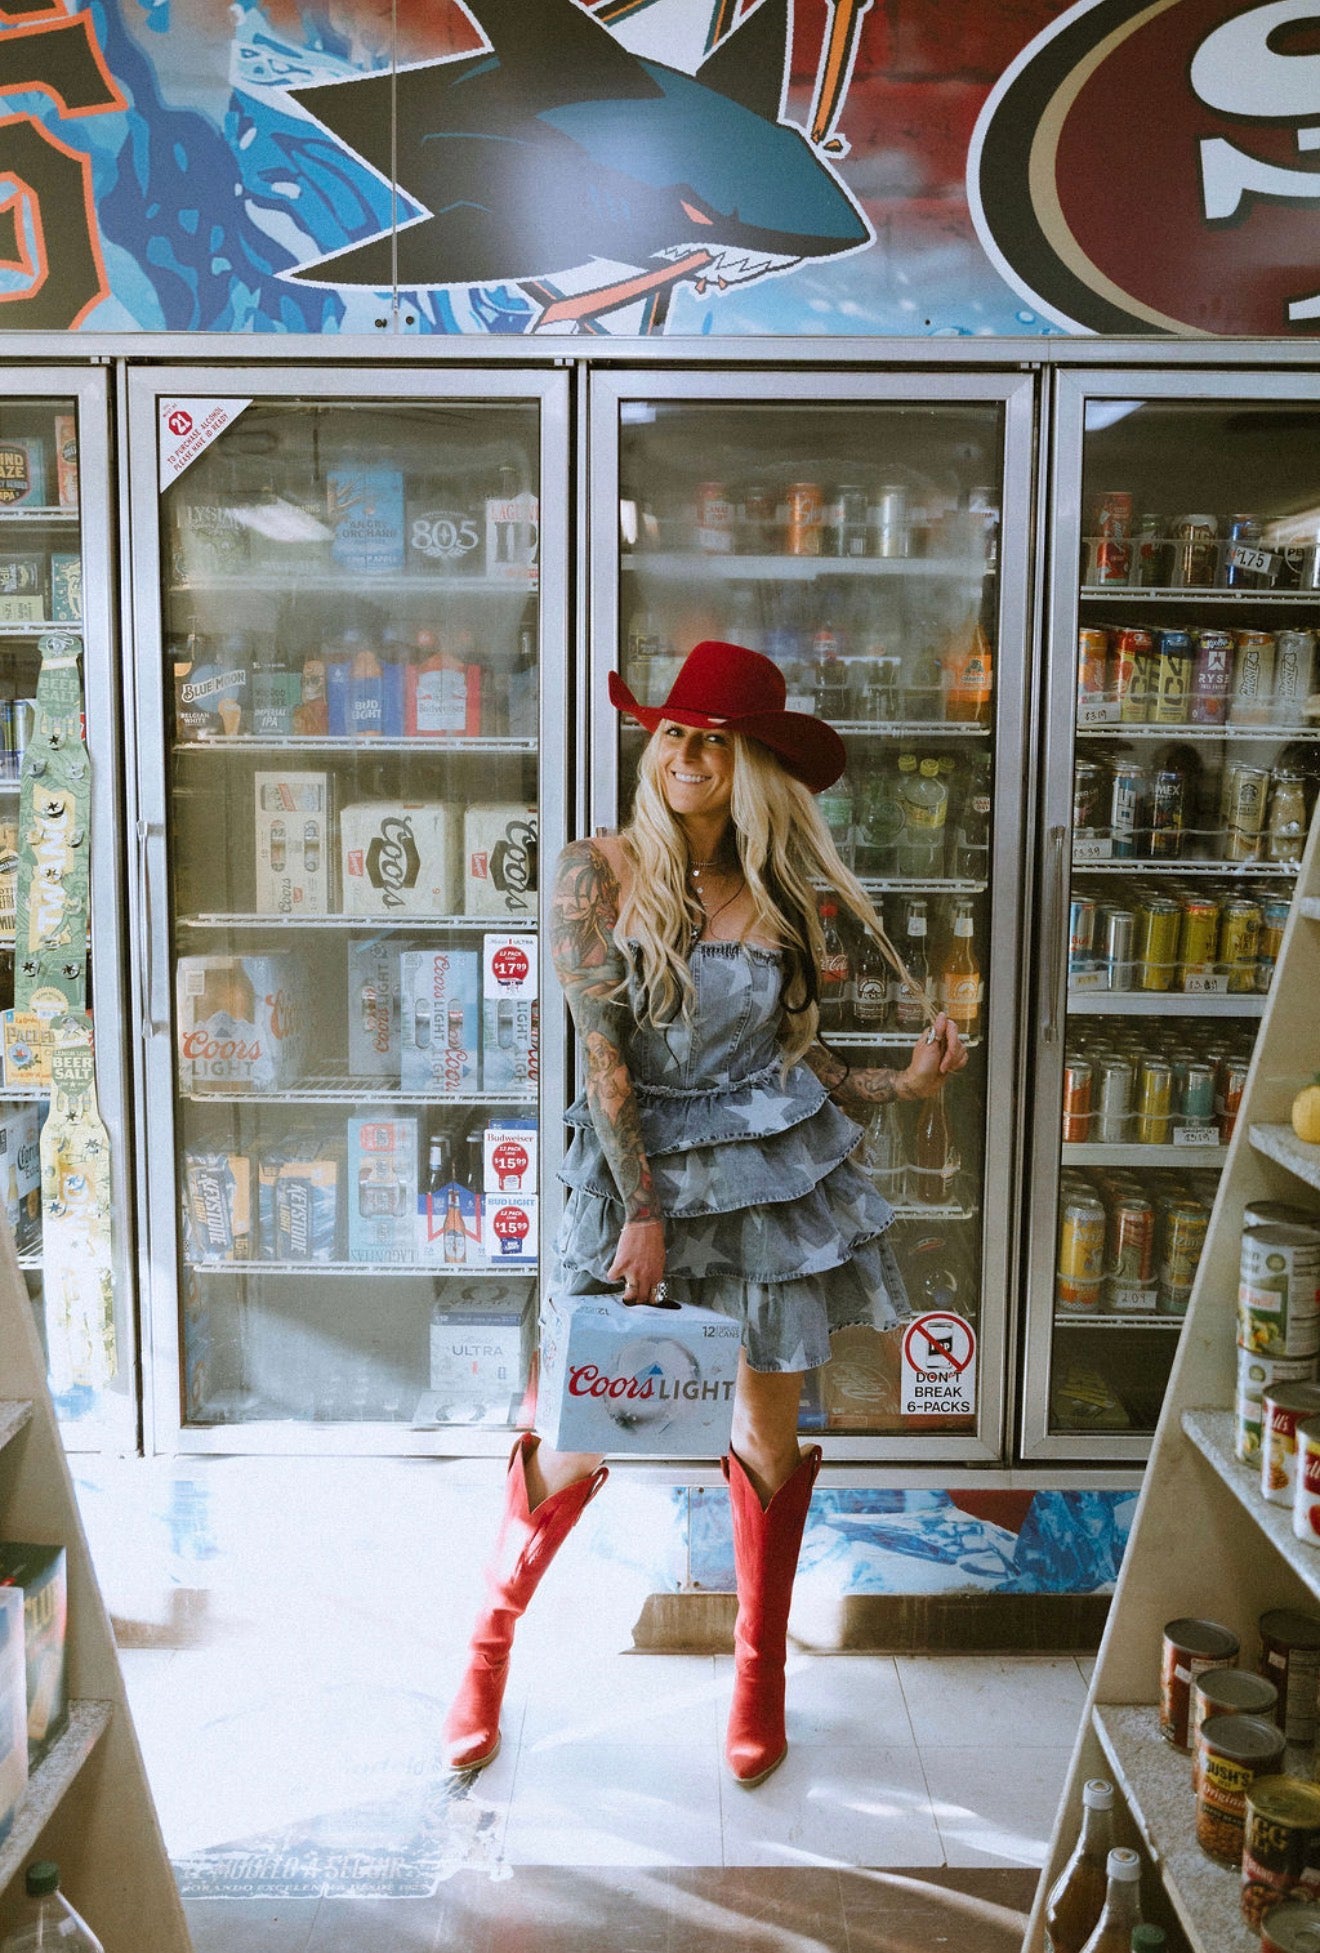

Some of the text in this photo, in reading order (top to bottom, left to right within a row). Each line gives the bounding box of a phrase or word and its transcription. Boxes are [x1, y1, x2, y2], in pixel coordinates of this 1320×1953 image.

[167, 406, 224, 464] TO PURCHASE ALCOHOL
[170, 412, 192, 434] 21
[173, 451, 194, 472] PLEASE
[191, 437, 206, 452] HAVE
[210, 413, 229, 431] READY
[411, 520, 479, 550] 805
[183, 671, 247, 702] BLUE MOON
[1198, 673, 1231, 685] RYSE
[354, 699, 379, 710] BUD
[380, 815, 413, 910] Coors
[505, 819, 538, 913] Coors
[378, 963, 390, 1006] LIGHT
[433, 955, 450, 1041] Coors LIGHT
[373, 1005, 390, 1054] Coors
[517, 1000, 528, 1042] LIGHT
[183, 1030, 262, 1060] Coors
[53, 1057, 92, 1068] BEER
[55, 1069, 91, 1080] SALT
[191, 1061, 254, 1076] LIGHT
[445, 1048, 469, 1092] Coor
[514, 1050, 527, 1091] LIGH
[487, 1134, 534, 1143] Budweiser
[193, 1195, 208, 1224] LIGHT
[197, 1174, 228, 1246] KEYSTONE
[279, 1204, 291, 1233] LIGHT
[287, 1184, 308, 1255] KEYSTONE
[702, 1326, 716, 1338] 12
[718, 1331, 740, 1339] CANS
[452, 1345, 503, 1356] ULTRA
[568, 1365, 736, 1401] Coors LIGHT
[914, 1387, 962, 1398] BREAK
[915, 1372, 962, 1383] DON'T
[906, 1401, 970, 1413] 6-PACKS
